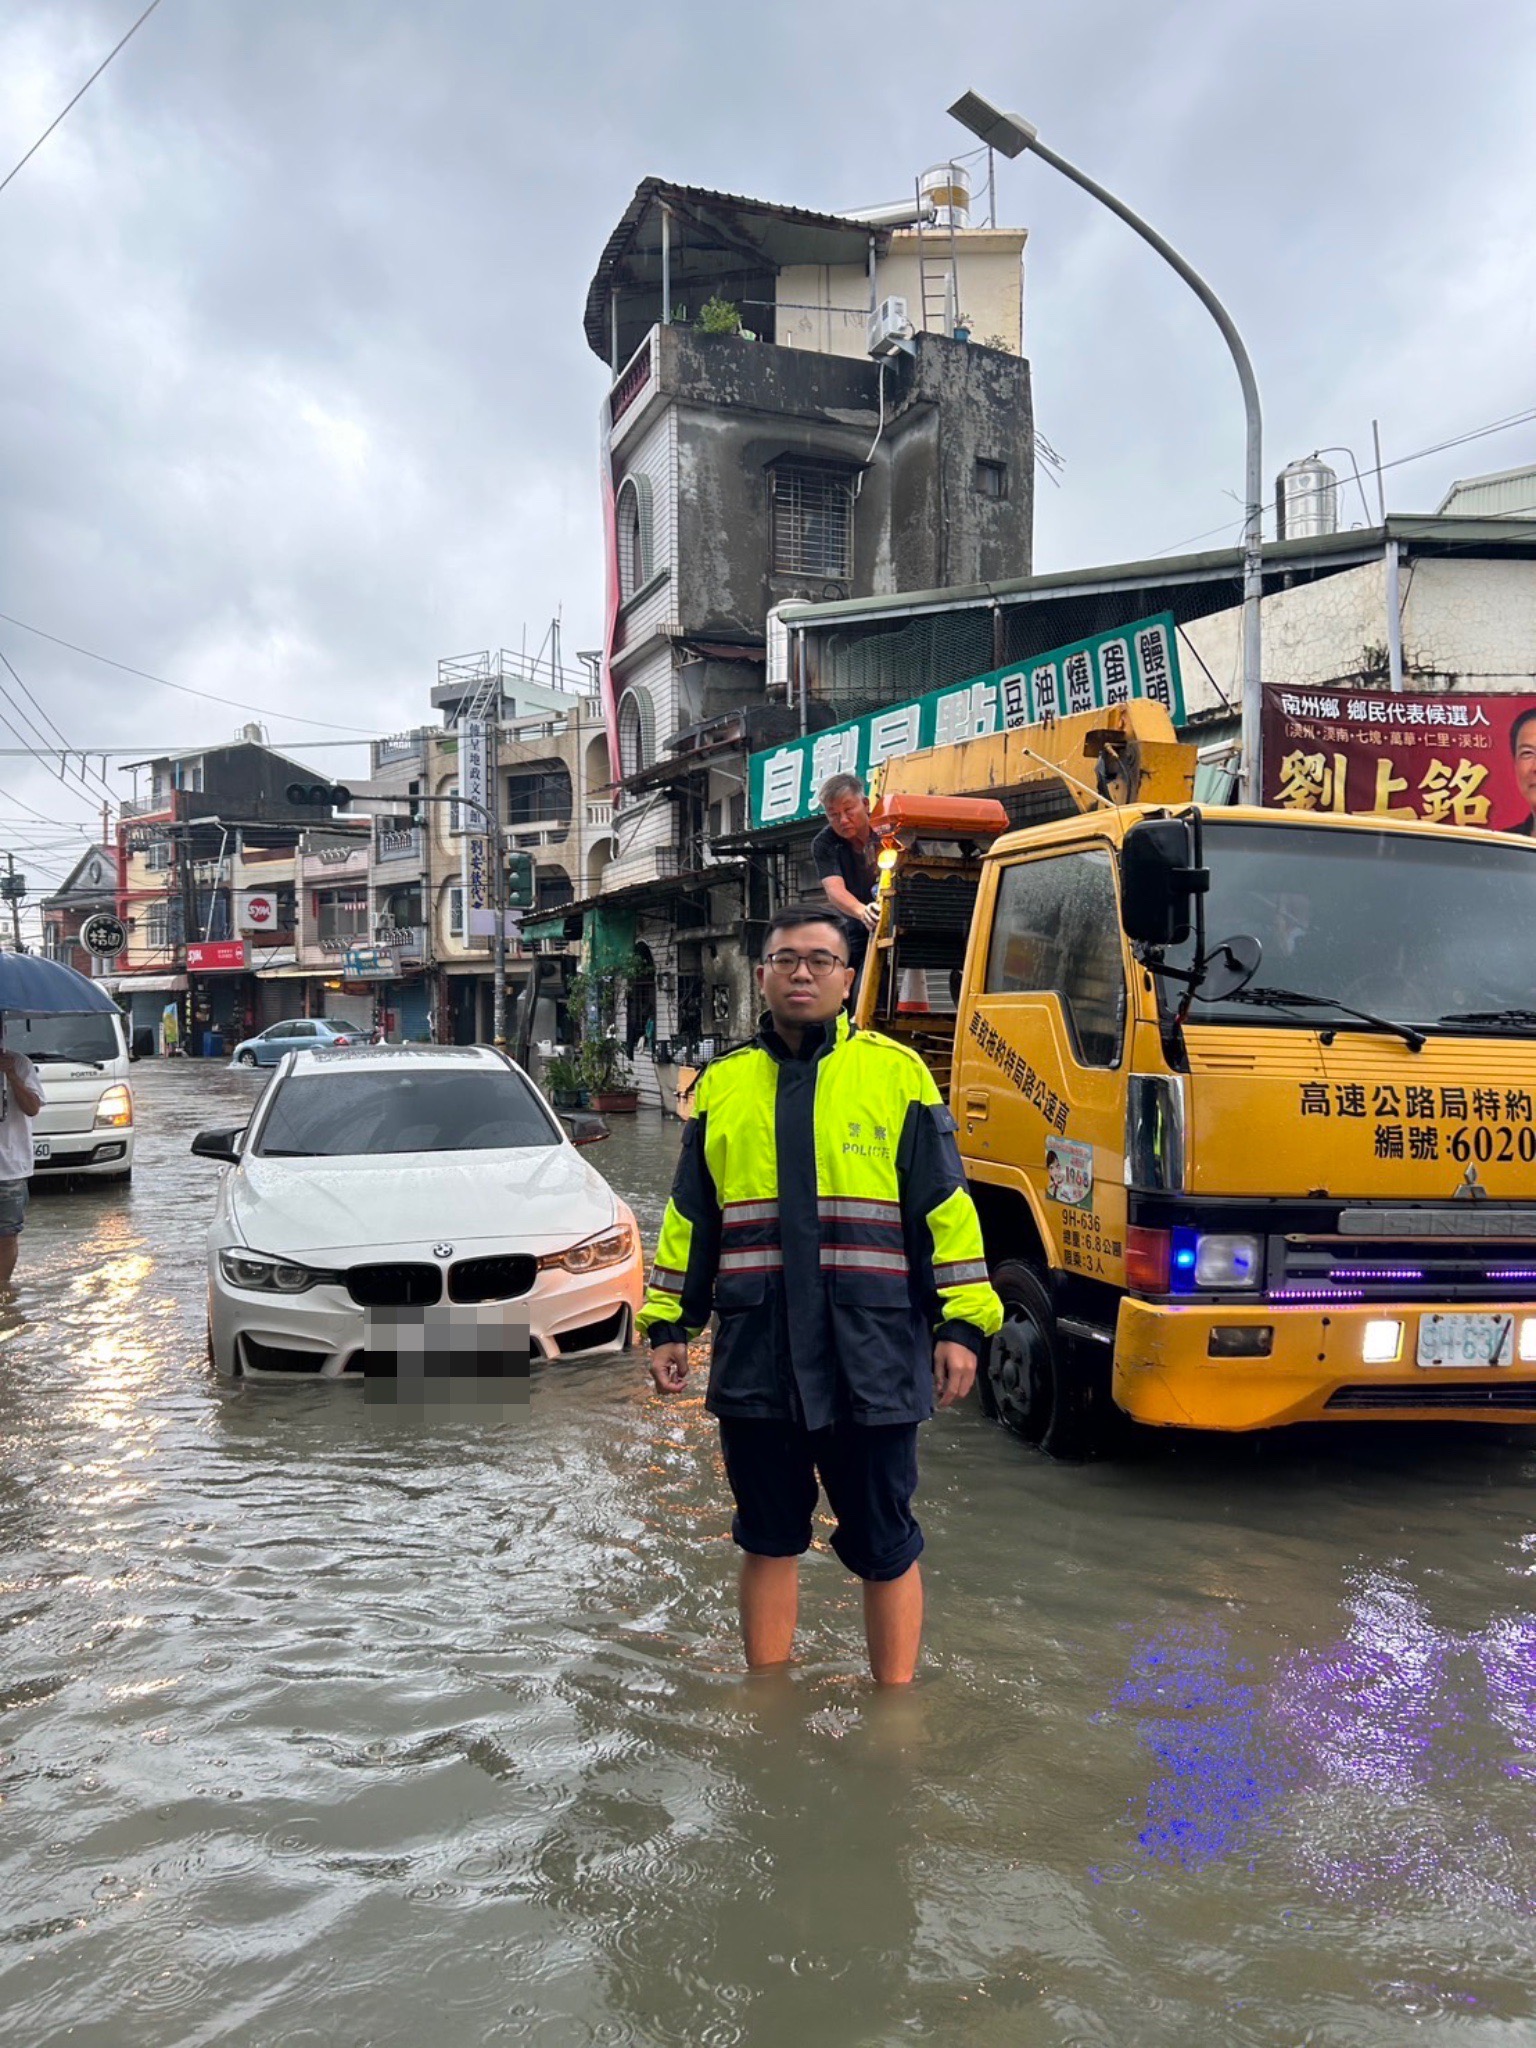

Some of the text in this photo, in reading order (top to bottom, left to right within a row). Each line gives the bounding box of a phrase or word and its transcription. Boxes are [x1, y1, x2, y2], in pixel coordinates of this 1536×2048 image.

[1281, 694, 1491, 727] 南州鄉 鄉民代表候選人
[1273, 749, 1493, 827] 劉上銘
[248, 905, 272, 918] SYM
[1299, 1082, 1533, 1122] 高速公路局特約
[33, 1143, 51, 1157] 60
[842, 1142, 891, 1160] POLICE
[1065, 1166, 1089, 1189] 1968
